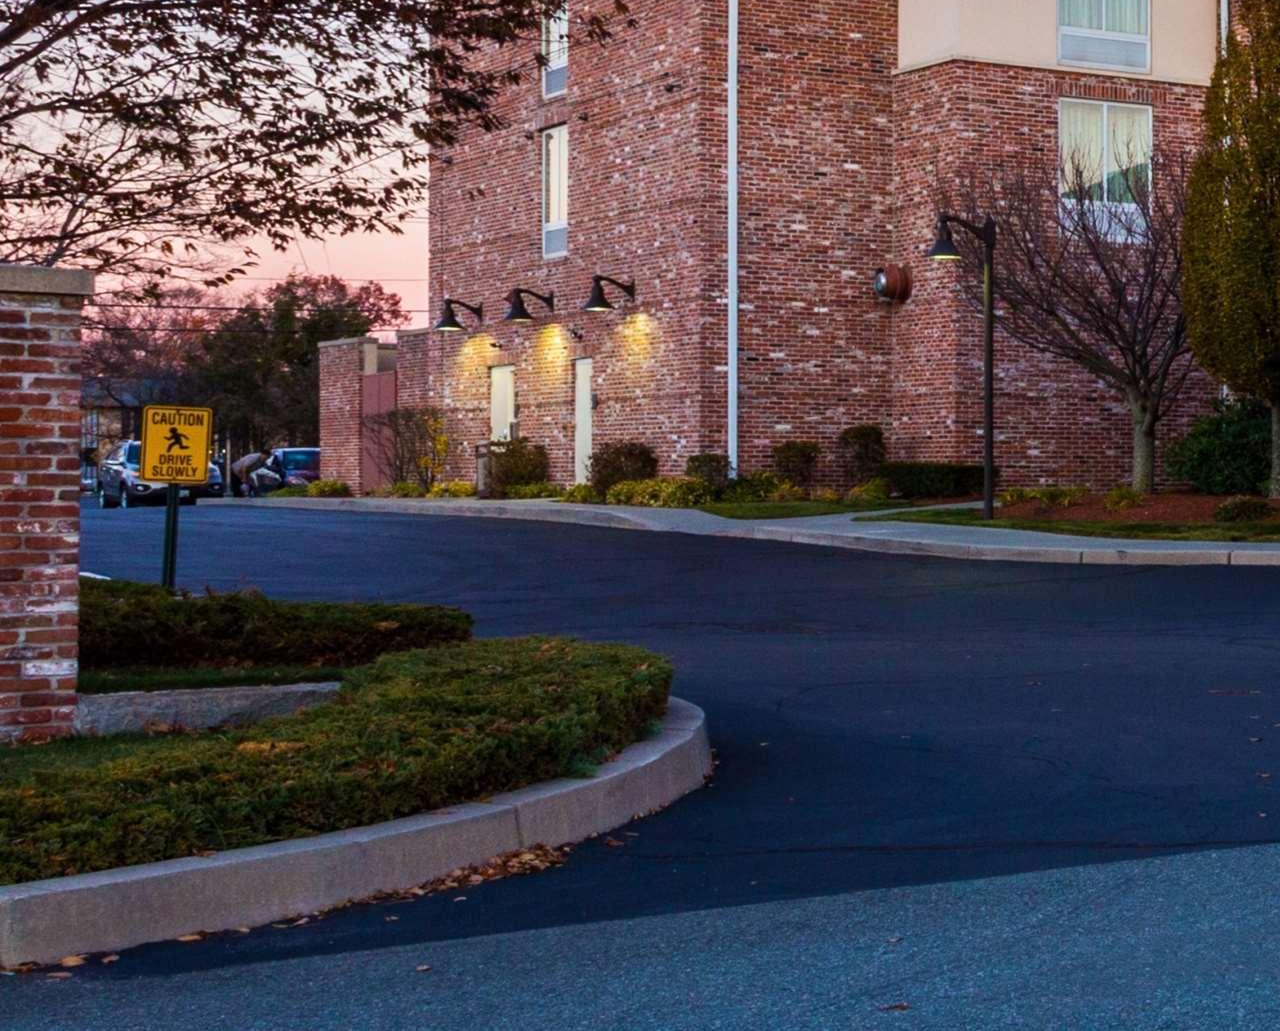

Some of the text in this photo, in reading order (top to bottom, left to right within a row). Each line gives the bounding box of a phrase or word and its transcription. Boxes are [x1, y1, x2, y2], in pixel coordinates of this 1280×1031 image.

[151, 411, 204, 426] CAUTION
[158, 454, 192, 465] DRIVE
[152, 465, 198, 478] SLOWLY
